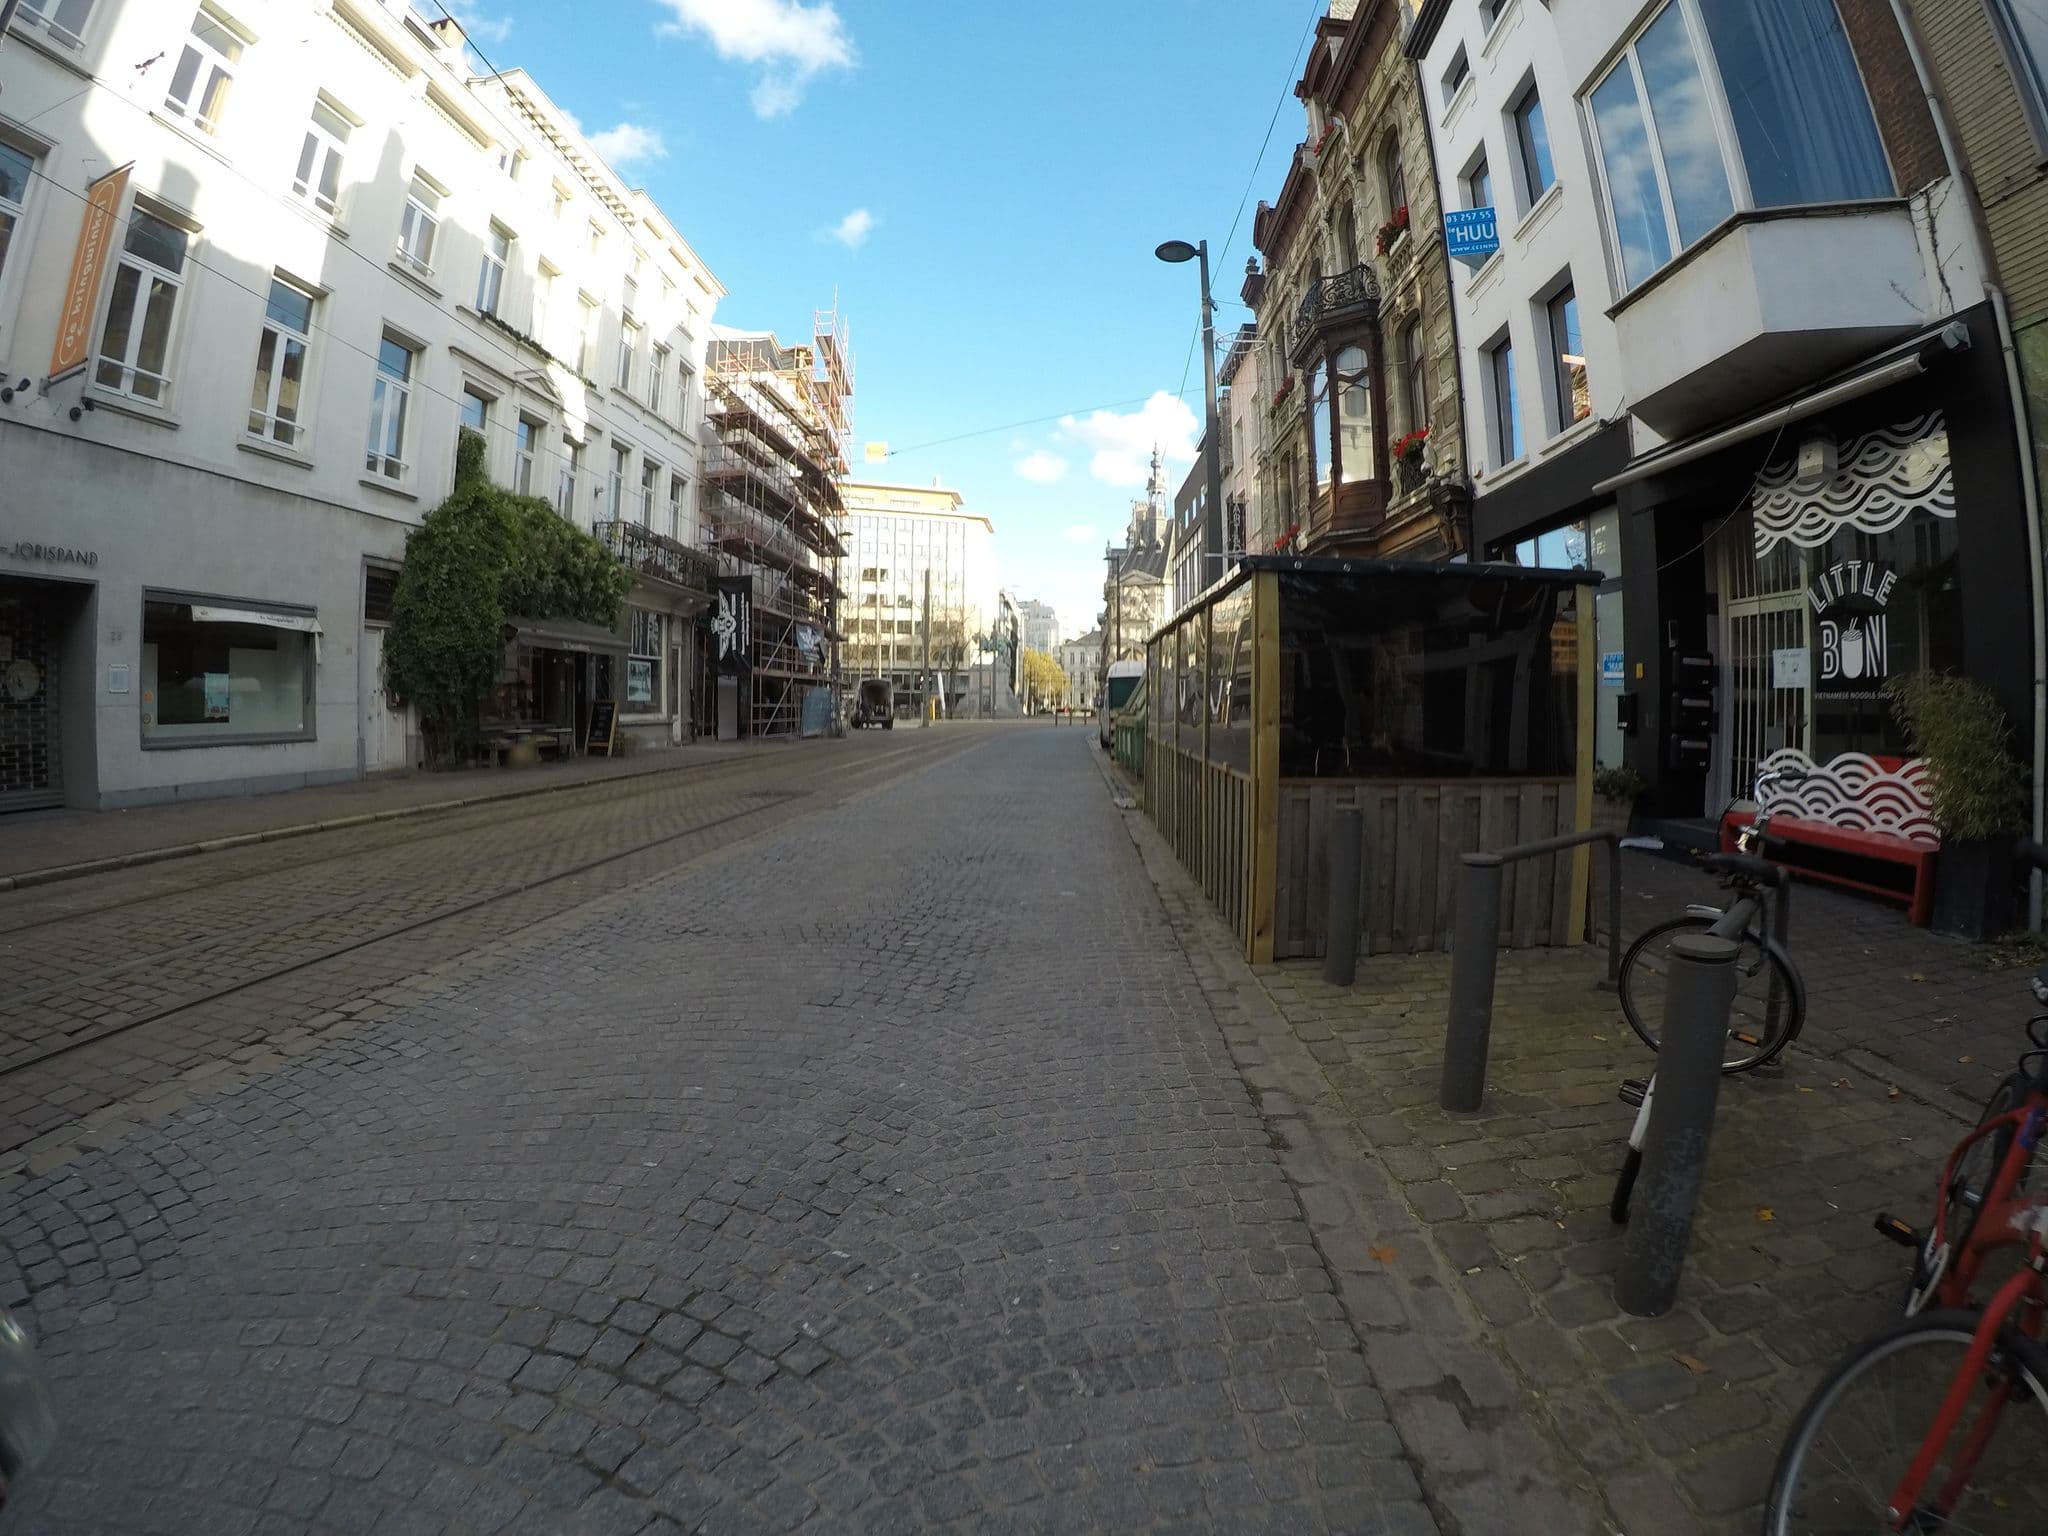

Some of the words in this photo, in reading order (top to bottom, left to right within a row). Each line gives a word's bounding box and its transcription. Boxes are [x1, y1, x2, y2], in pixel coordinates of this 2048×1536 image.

[1446, 214, 1458, 223] 03
[1460, 212, 1477, 221] 257
[1479, 210, 1492, 219] 55
[1807, 560, 1898, 614] LITTLE
[1815, 691, 1849, 700] VIETNAMESE
[1850, 690, 1876, 700] NOODLE
